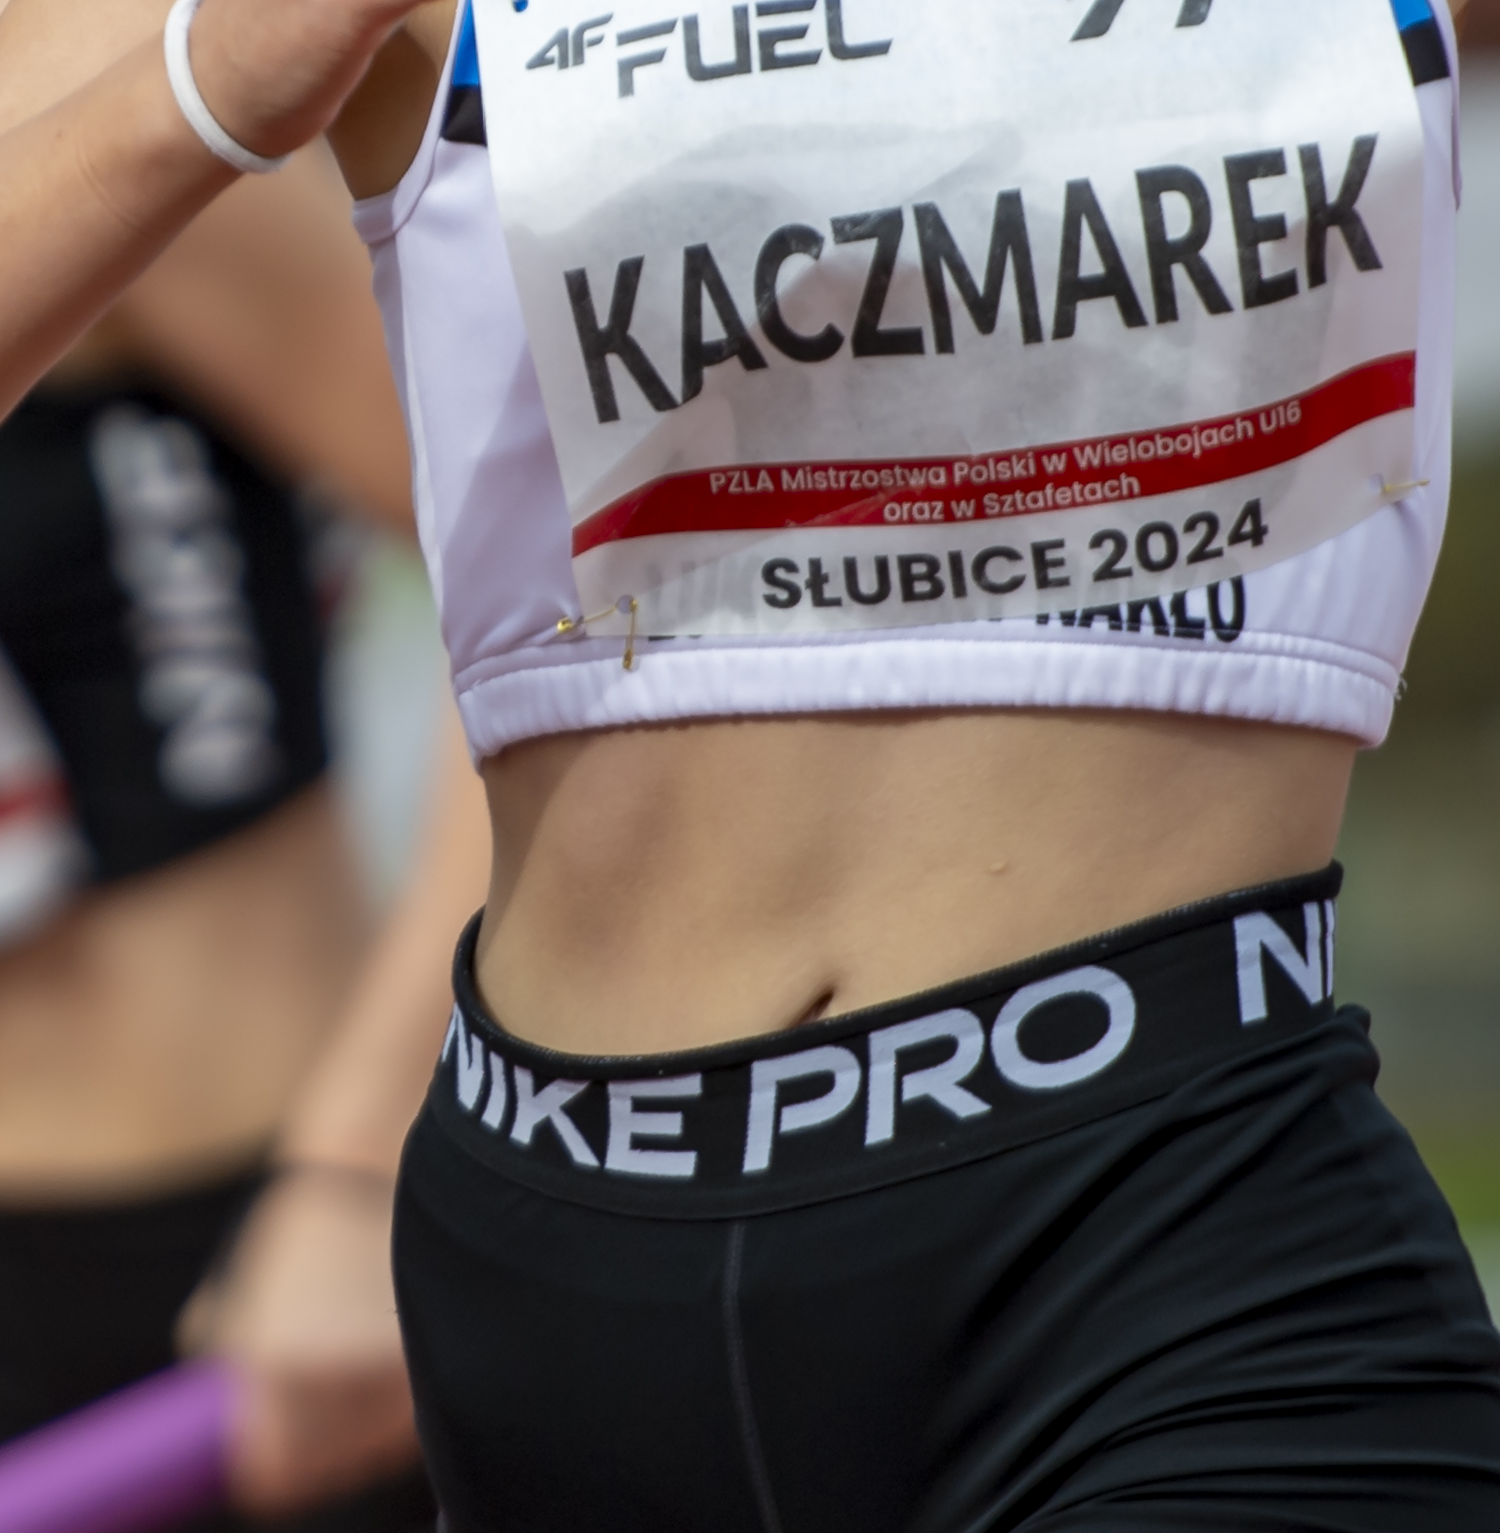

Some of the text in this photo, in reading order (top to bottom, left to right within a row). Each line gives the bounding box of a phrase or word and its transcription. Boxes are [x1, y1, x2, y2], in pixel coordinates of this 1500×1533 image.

[563, 133, 1384, 424] KACZMAREK
[709, 399, 1302, 495] PZLA Mistrzostwa Polski w Wielobojach U16
[883, 472, 1141, 523] oraz w Sztafetach
[761, 497, 1269, 609] SŁUBICE 2024
[441, 1001, 703, 1178] NIKE
[742, 963, 1137, 1173] PRO
